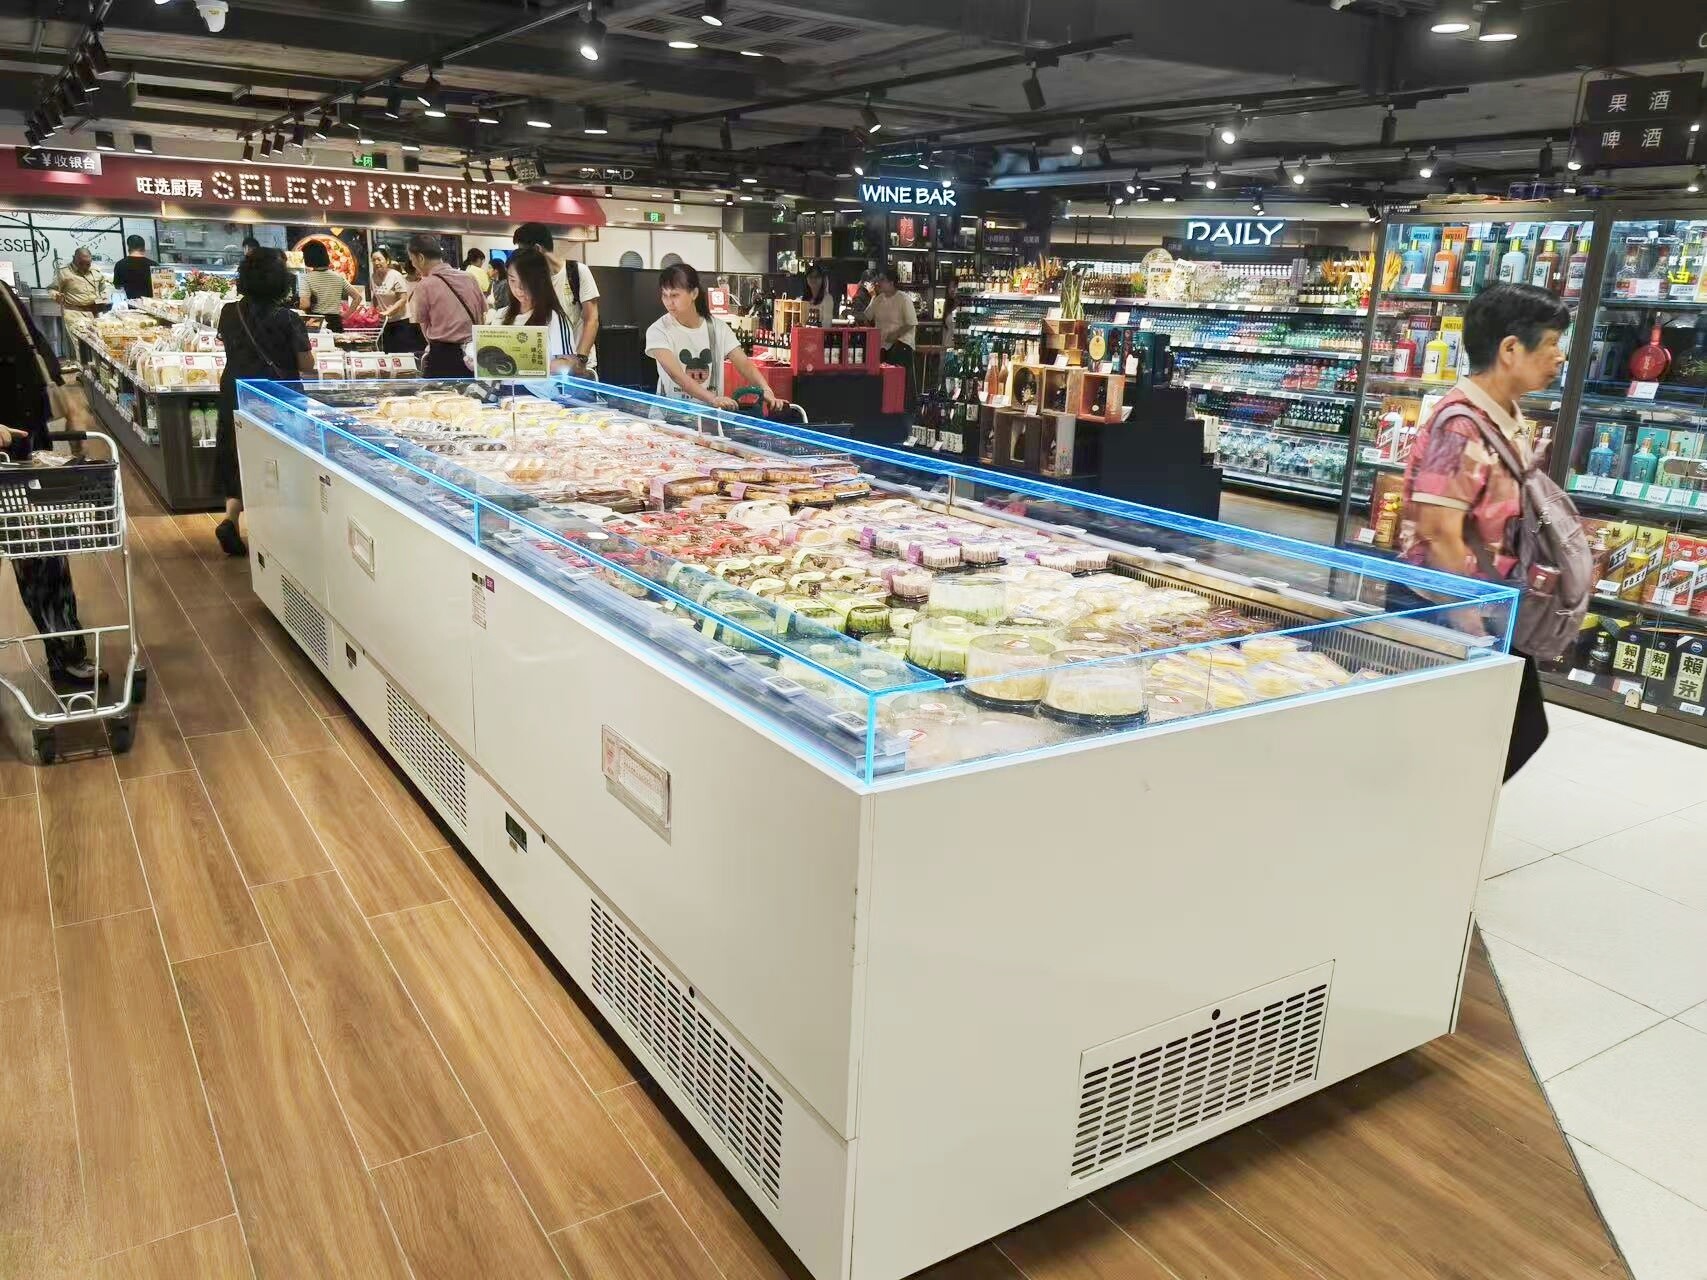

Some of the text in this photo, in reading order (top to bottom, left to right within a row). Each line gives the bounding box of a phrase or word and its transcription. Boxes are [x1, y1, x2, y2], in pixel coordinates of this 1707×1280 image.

[579, 168, 634, 180] SALAD
[136, 177, 203, 198] 旺选厨房
[211, 170, 511, 216] SELECT KITCHEN
[862, 184, 957, 206] WINE BAR
[1186, 221, 1284, 246] DAILY
